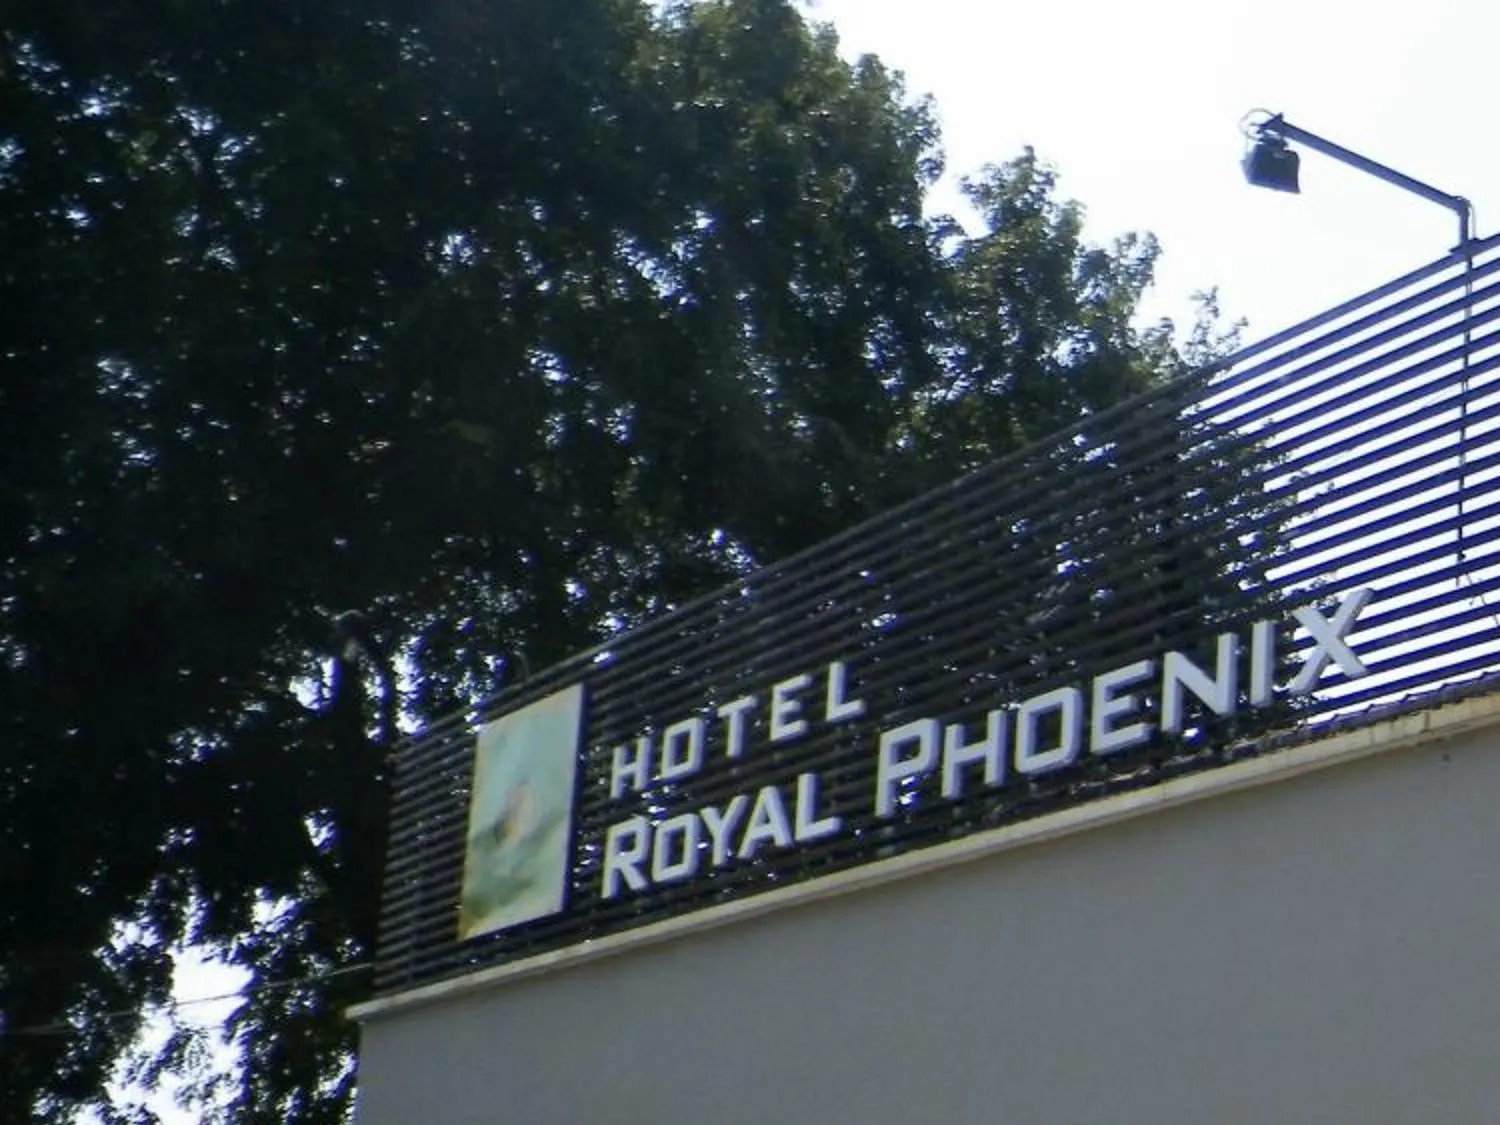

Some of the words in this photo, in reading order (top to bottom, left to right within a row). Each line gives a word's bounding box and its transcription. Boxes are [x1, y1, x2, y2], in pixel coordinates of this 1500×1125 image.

[600, 773, 841, 899] ROYAL
[875, 587, 1374, 818] PHOENIX
[610, 661, 866, 799] HOTEL
